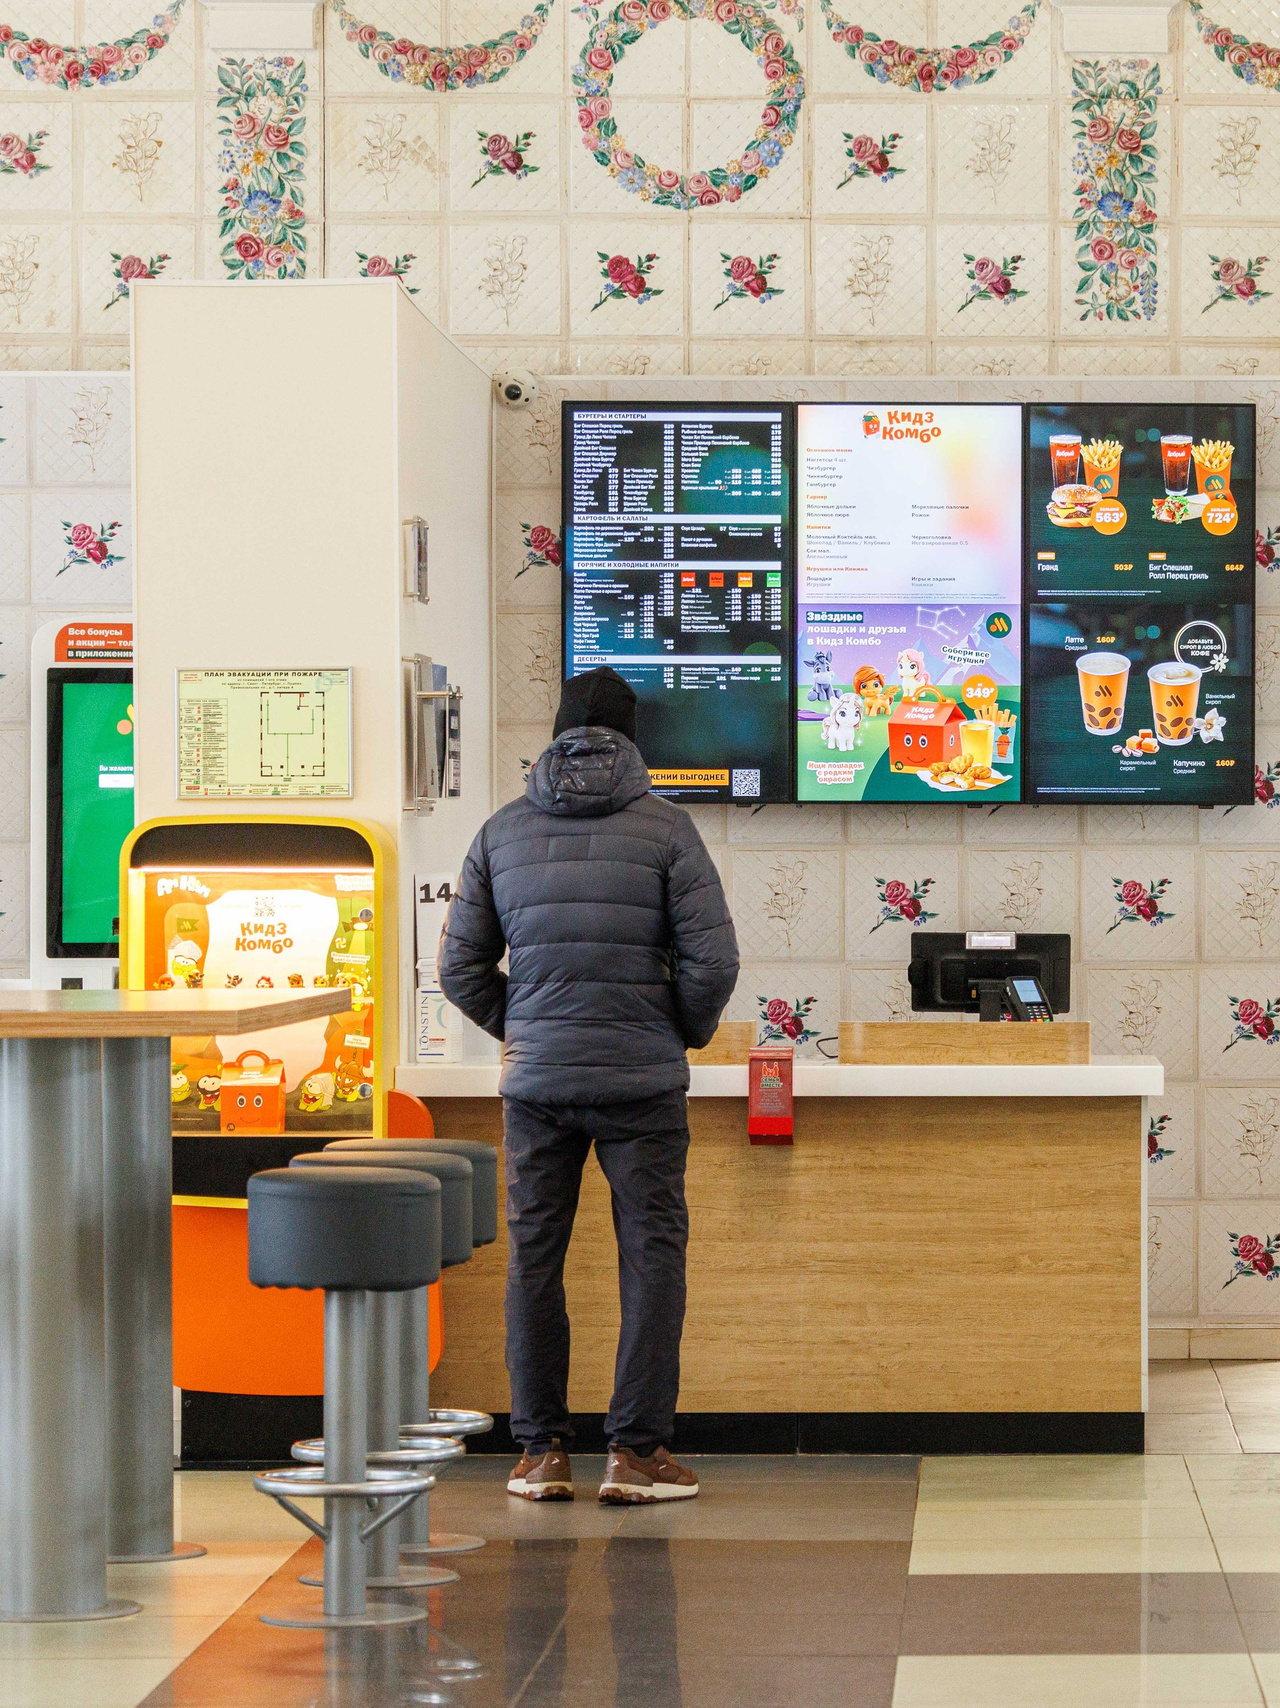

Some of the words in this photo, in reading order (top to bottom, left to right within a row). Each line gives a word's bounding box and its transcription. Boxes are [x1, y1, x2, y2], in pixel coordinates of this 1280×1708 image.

[887, 410, 934, 426] Кидз
[882, 426, 942, 443] Комбо
[1037, 564, 1059, 572] Гранд
[1166, 572, 1188, 580] Перец
[807, 612, 863, 622] Звёздные
[68, 628, 85, 636] Все
[87, 628, 123, 636] бонусы
[807, 626, 857, 634] лошадки
[868, 625, 907, 635] друзья
[76, 640, 105, 648] акции
[816, 637, 844, 647] Кидз
[846, 637, 881, 646] Комбо
[1064, 636, 1085, 644] Латте
[942, 646, 974, 657] Собери
[948, 654, 985, 665] игрушки
[911, 706, 935, 714] Кидз
[904, 712, 935, 720] Комбо
[808, 762, 826, 770] Ищи
[828, 762, 863, 770] лошадок
[1173, 760, 1206, 768] Капучино
[680, 773, 726, 781] ВЫГОДНЕЕ
[240, 922, 288, 938] Кидз
[235, 937, 293, 954] Комбо
